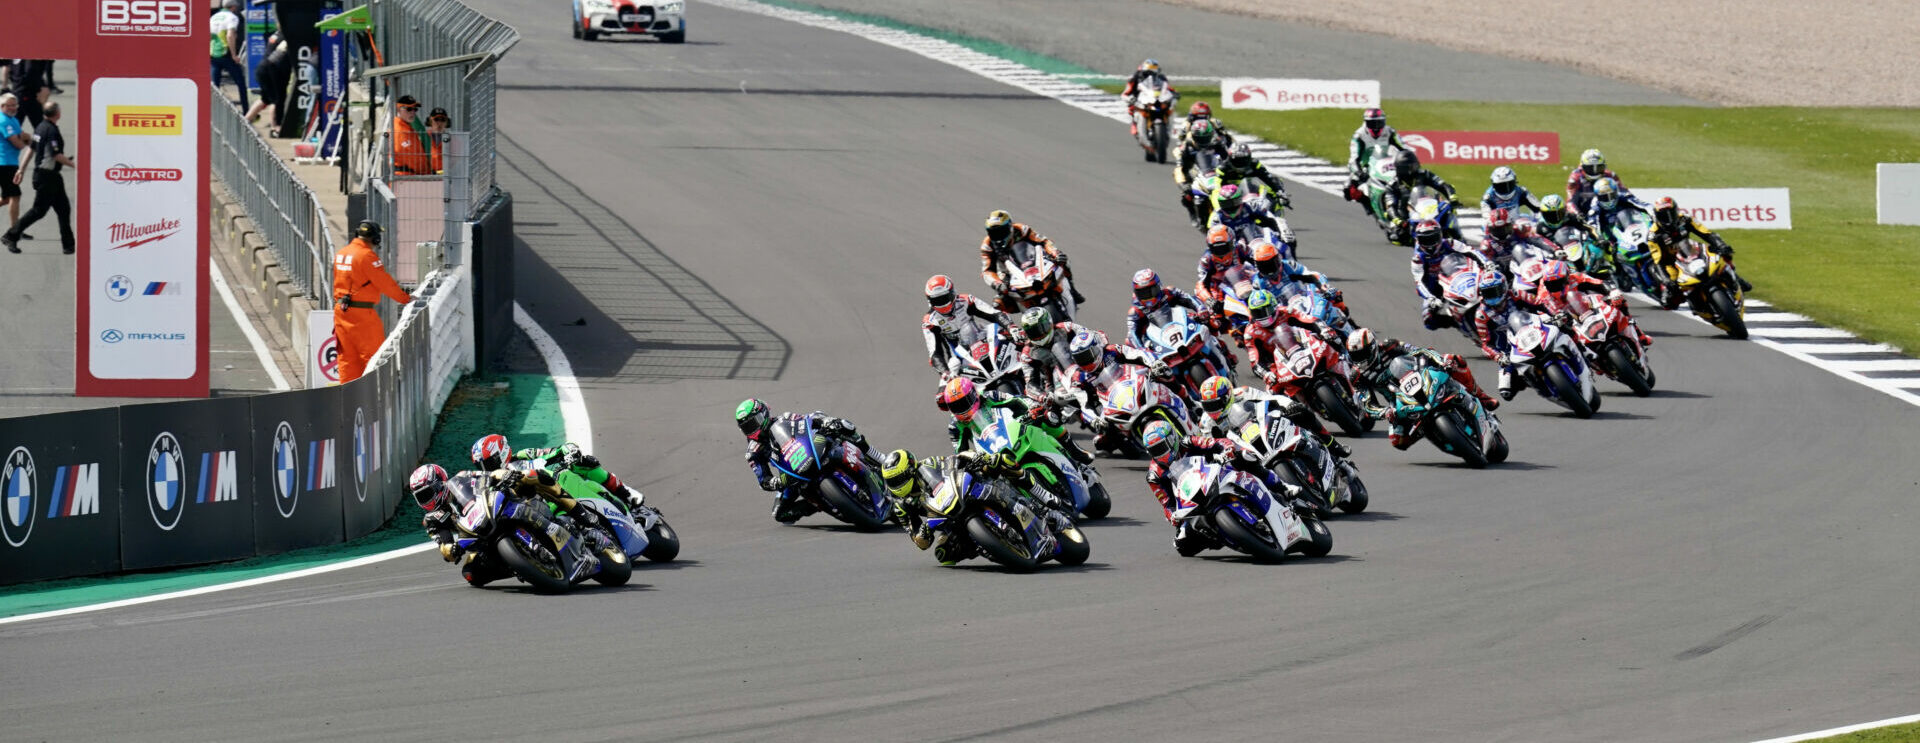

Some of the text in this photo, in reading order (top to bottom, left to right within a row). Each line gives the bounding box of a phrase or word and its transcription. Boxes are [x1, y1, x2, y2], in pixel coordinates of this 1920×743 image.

[101, 0, 187, 25] BSB
[297, 46, 313, 110] RAPID
[332, 44, 340, 98] PERFORMANCE
[326, 70, 334, 97] CROWE
[1277, 90, 1369, 104] Bennetts
[112, 113, 176, 127] PIRELLI
[1443, 141, 1549, 160] Bennetts
[109, 169, 177, 179] QUATTRO
[1678, 204, 1776, 221] ennetts
[106, 217, 180, 243] Milwaukee
[789, 446, 808, 470] 22
